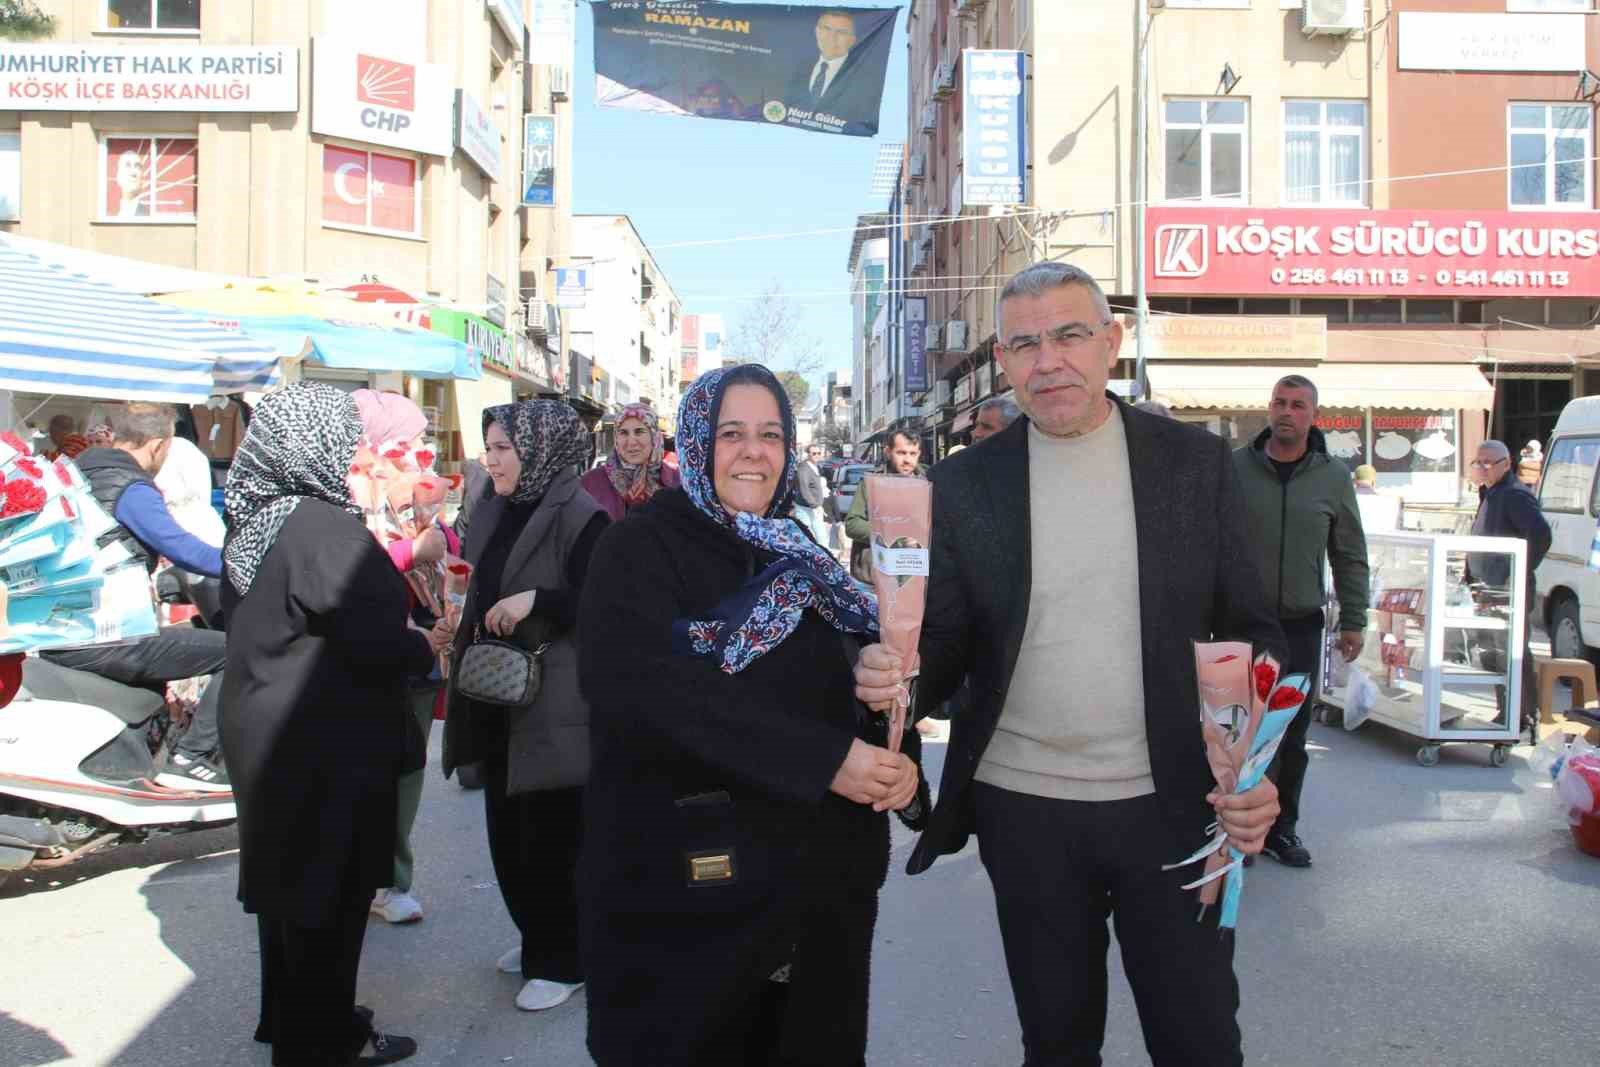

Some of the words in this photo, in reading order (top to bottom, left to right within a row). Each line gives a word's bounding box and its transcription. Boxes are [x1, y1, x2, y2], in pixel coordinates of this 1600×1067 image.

[644, 12, 751, 34] RAMAZAN
[132, 56, 194, 75] HALK
[201, 52, 284, 76] PARTİSİ
[8, 76, 68, 103] KÖŞK
[76, 78, 116, 103] İLÇE
[122, 79, 251, 104] BAŞKANLIĞI
[360, 106, 412, 133] CHP
[1217, 218, 1322, 260] KÖŞK
[1331, 220, 1488, 258] SÜRÜCÜ
[1497, 227, 1600, 258] KURS
[1271, 267, 1286, 284] 0
[1290, 268, 1326, 284] 256
[1331, 269, 1365, 285] 461
[1367, 269, 1385, 285] 11
[1390, 269, 1409, 286] 13
[1436, 270, 1451, 286] 0
[1454, 270, 1488, 286] 541
[1490, 270, 1525, 286] 461
[1528, 271, 1545, 286] 11
[1549, 271, 1569, 287] 13
